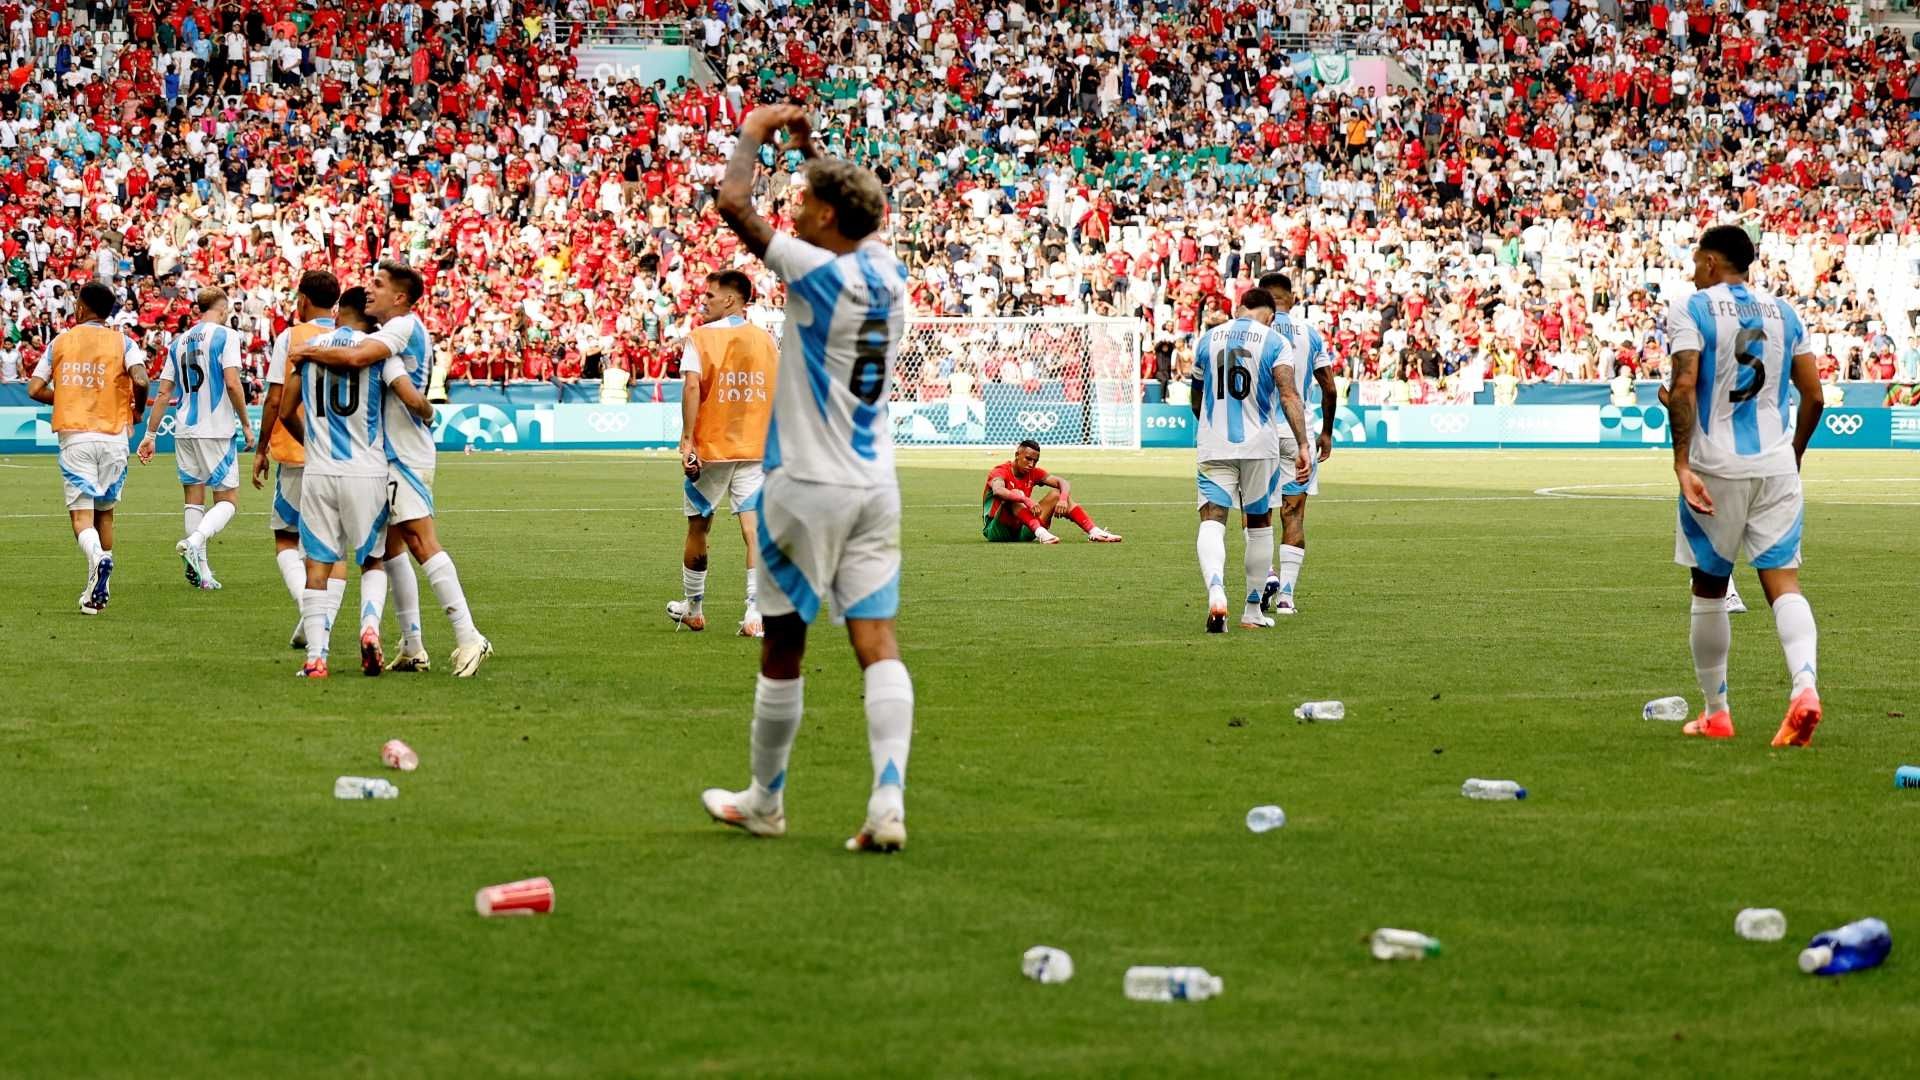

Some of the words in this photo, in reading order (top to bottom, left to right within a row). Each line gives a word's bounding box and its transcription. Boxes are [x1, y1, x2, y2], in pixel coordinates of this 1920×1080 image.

[1212, 329, 1263, 345] OTAMENDI
[62, 361, 106, 375] PARIS
[180, 348, 205, 394] 15
[1216, 345, 1253, 401] 16
[1728, 327, 1768, 404] 5
[61, 373, 105, 389] 2024
[718, 370, 766, 386] PARIS
[315, 364, 360, 418] 10
[718, 387, 767, 403] 2024
[1145, 415, 1187, 429] 2024
[387, 480, 399, 506] 7
